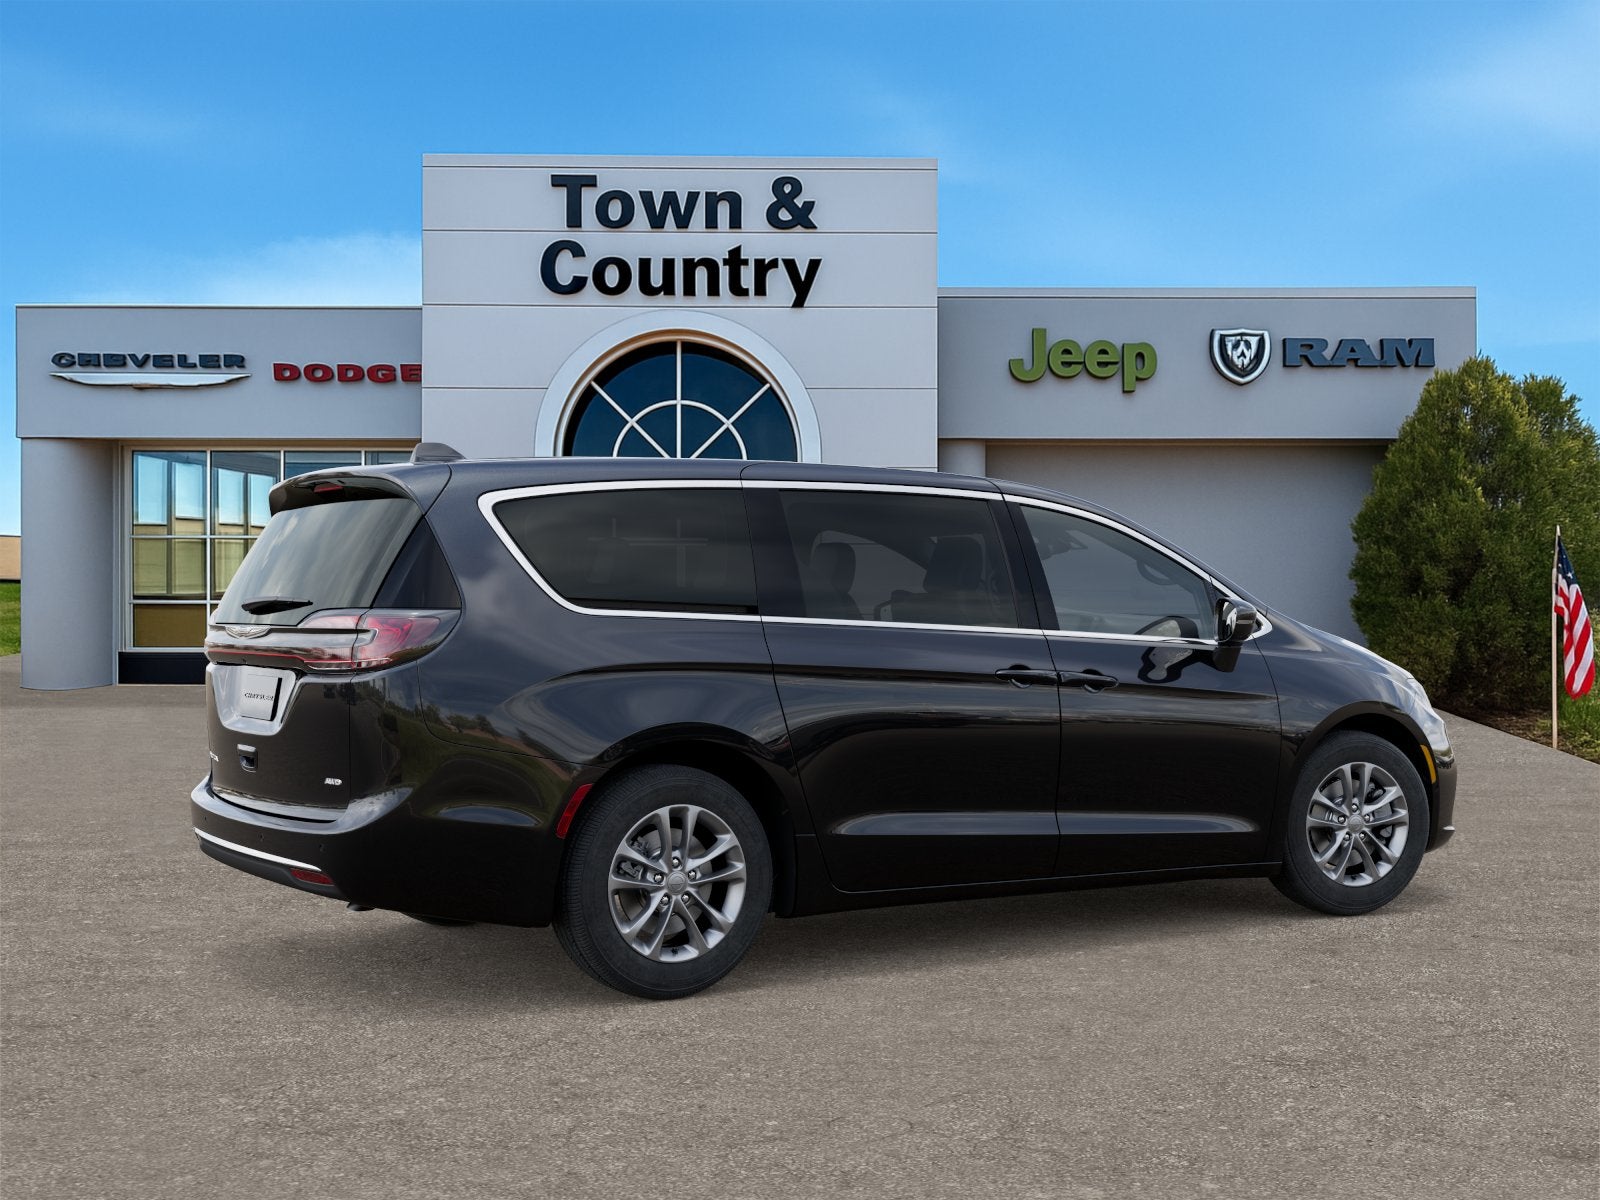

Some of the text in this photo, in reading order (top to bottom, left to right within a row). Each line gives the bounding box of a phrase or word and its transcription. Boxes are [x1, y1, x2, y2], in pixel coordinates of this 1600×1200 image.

[550, 174, 818, 230] Town &
[540, 239, 823, 308] Country
[272, 362, 422, 383] DODGE
[1009, 328, 1157, 393] Jeep
[1282, 337, 1435, 368] RAM
